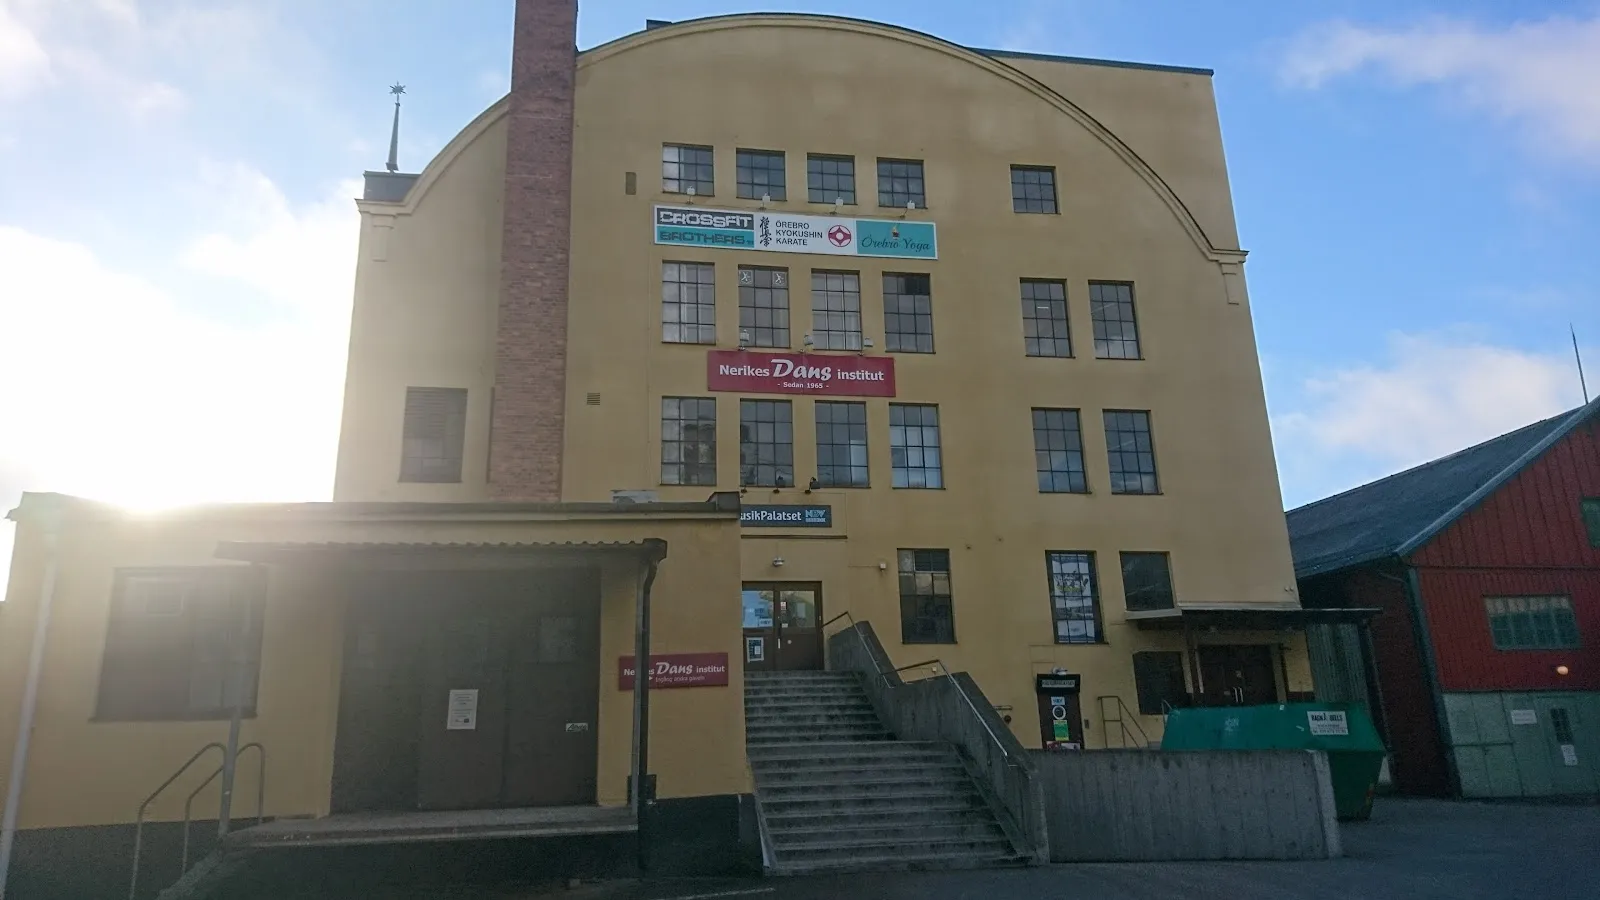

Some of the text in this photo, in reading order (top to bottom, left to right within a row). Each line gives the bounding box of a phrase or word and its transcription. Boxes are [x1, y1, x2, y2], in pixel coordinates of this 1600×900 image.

[660, 211, 752, 228] CROSSFIT
[775, 219, 809, 230] ÖREBRO
[660, 231, 745, 245] BROTHERS
[775, 229, 823, 239] KYOKUSHIN
[776, 237, 808, 246] KARATE
[861, 233, 932, 253] Örebro Yoga
[719, 358, 885, 381] Nerikes Dans institut
[783, 381, 804, 389] Sedan
[740, 510, 802, 521] usikPalatset
[656, 661, 693, 675] Dans
[696, 665, 725, 673] institut
